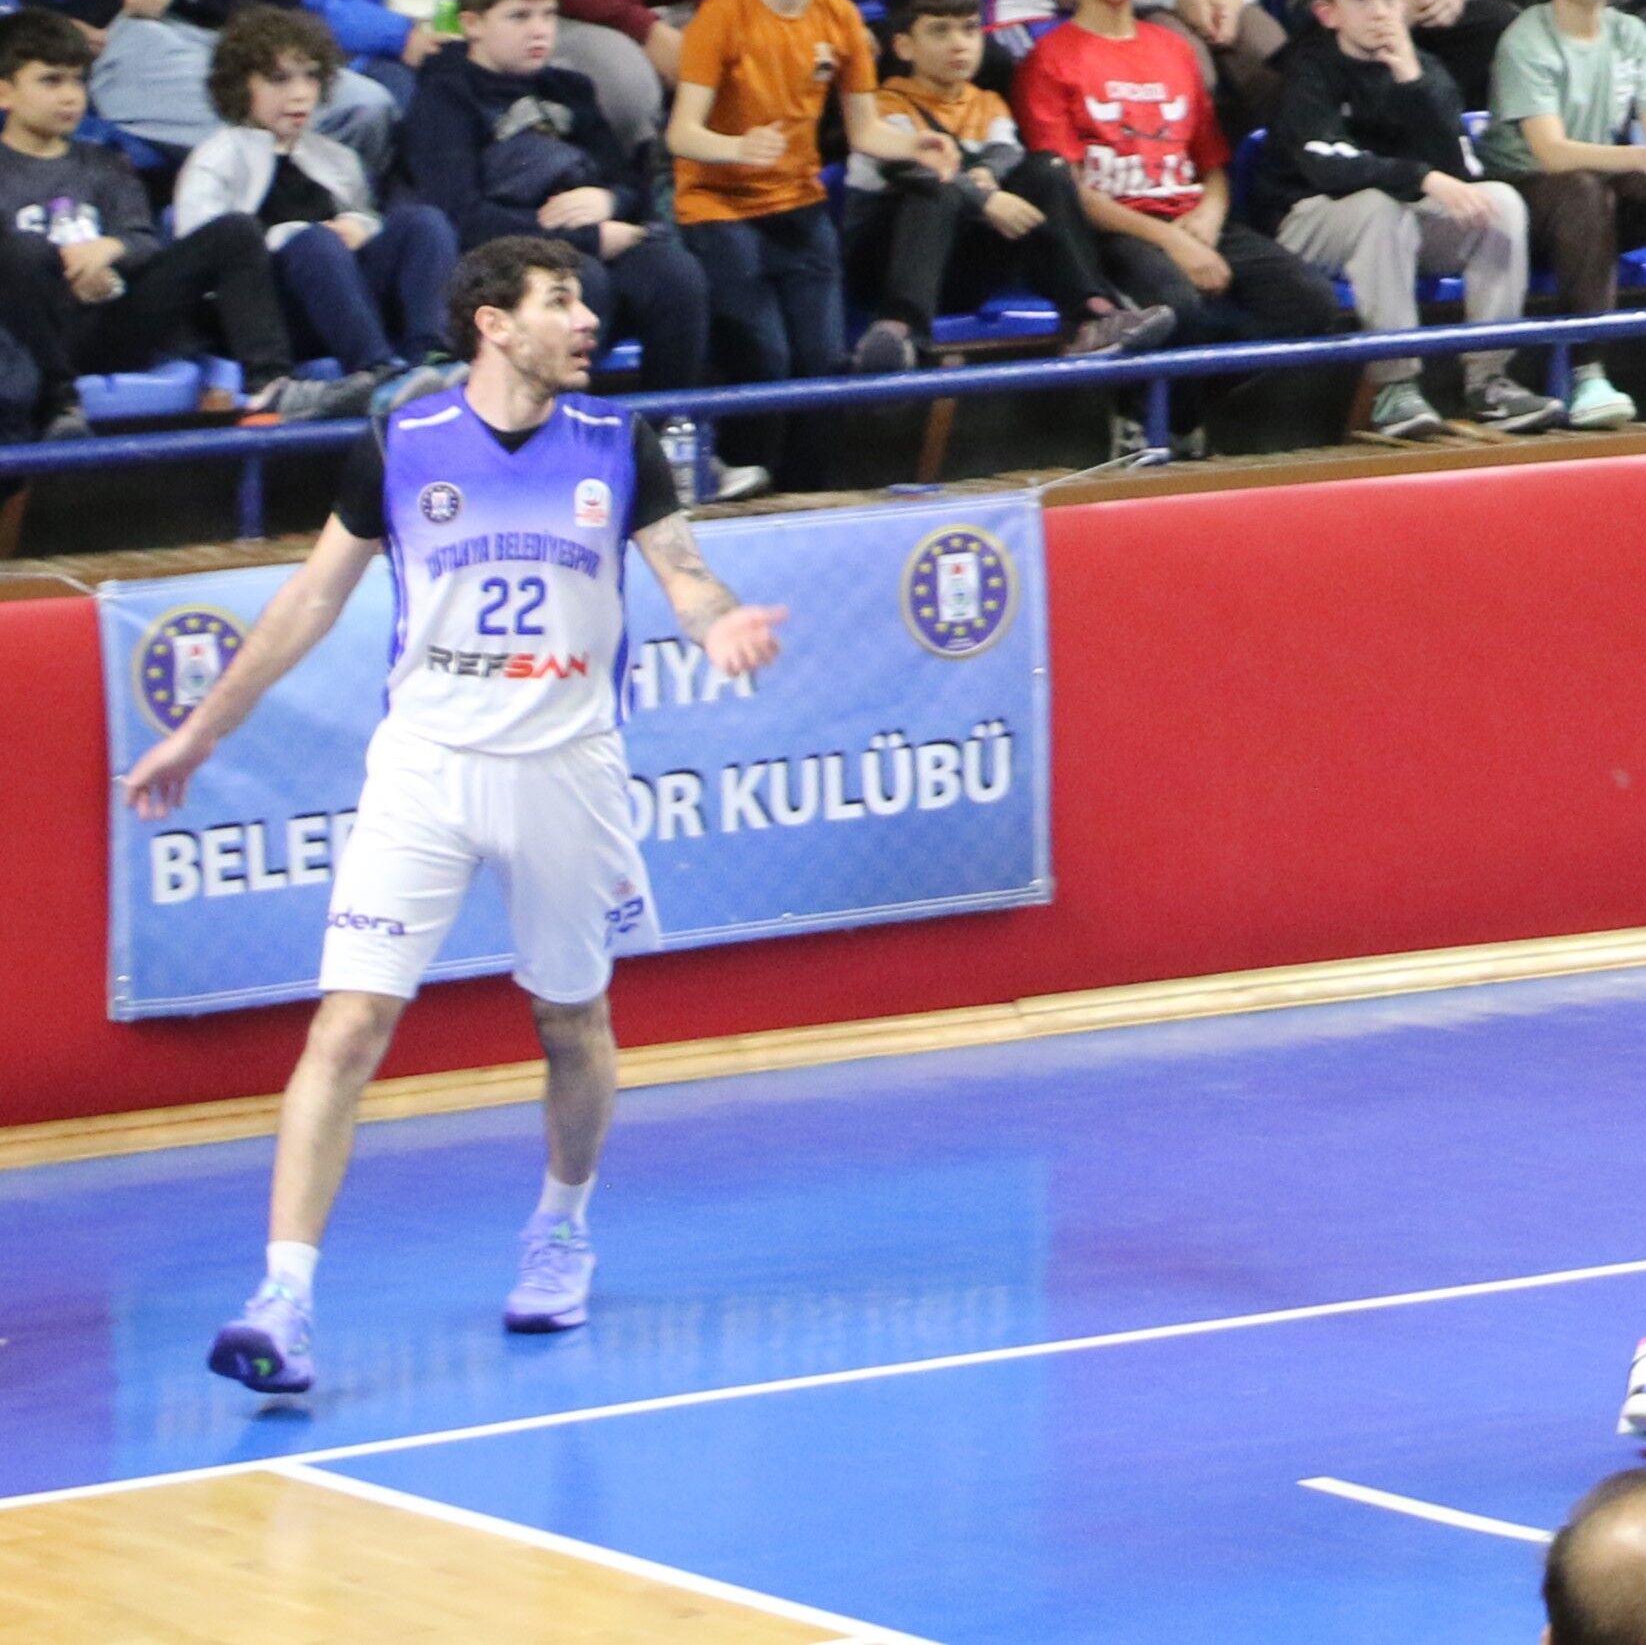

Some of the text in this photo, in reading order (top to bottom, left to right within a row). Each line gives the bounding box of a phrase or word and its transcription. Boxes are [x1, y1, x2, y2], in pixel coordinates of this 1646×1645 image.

[477, 575, 547, 636] 22
[427, 645, 591, 680] REFSAN
[720, 718, 1014, 834] KULÜBÜ
